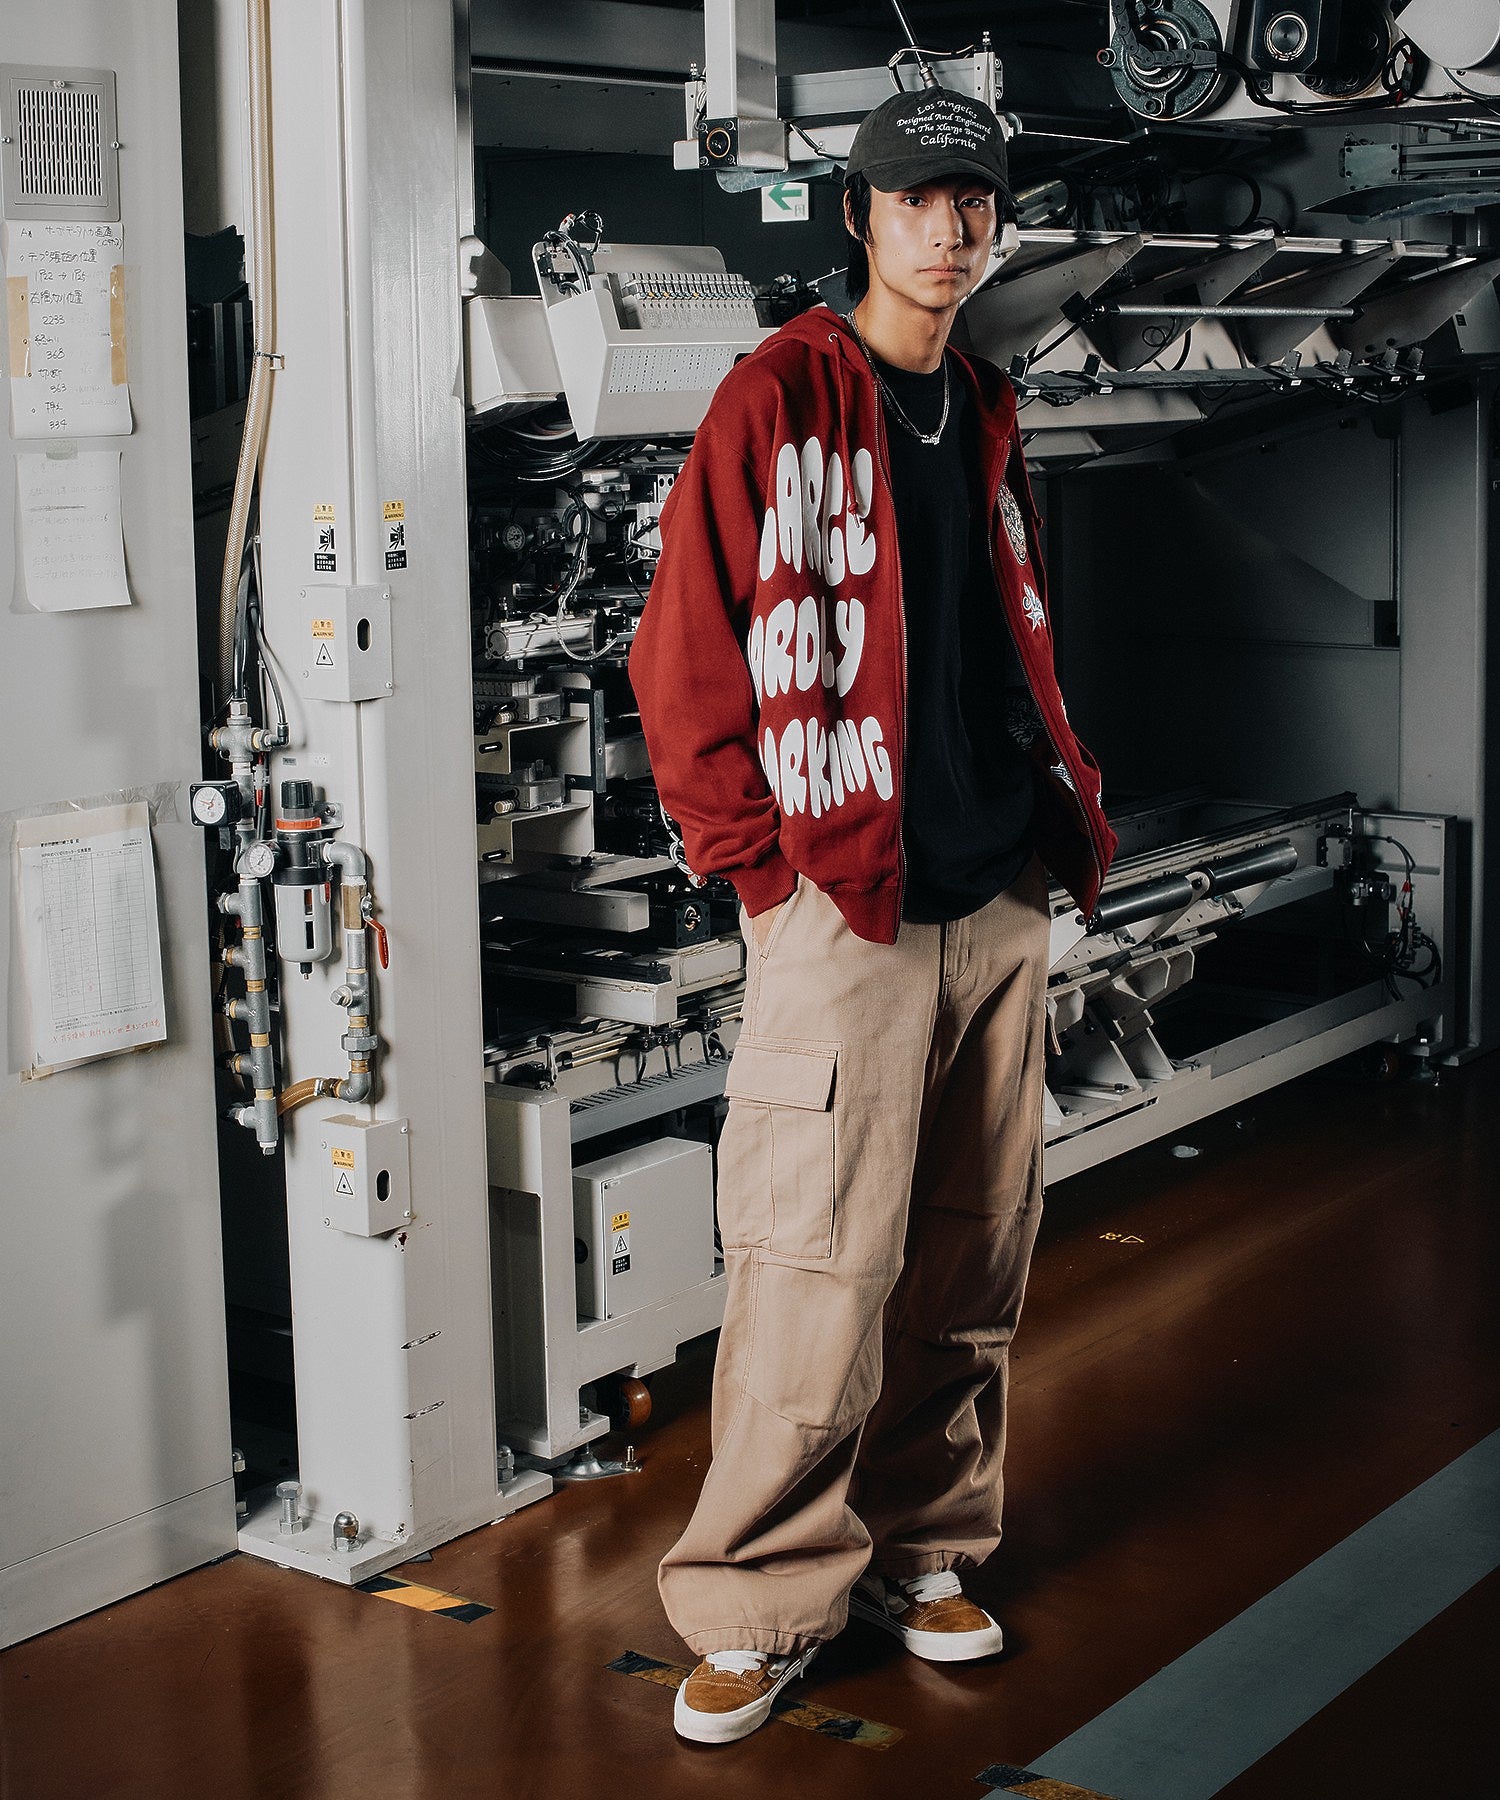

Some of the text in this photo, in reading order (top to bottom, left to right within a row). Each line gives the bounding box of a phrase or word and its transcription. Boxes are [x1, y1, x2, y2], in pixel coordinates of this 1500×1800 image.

[917, 100, 978, 119] Los Angeles
[896, 112, 934, 127] Designed
[934, 112, 953, 121] And
[904, 122, 986, 142] In The Xlarge Brand
[920, 133, 977, 151] California
[41, 314, 66, 326] 2233
[747, 596, 865, 709] ARDLY
